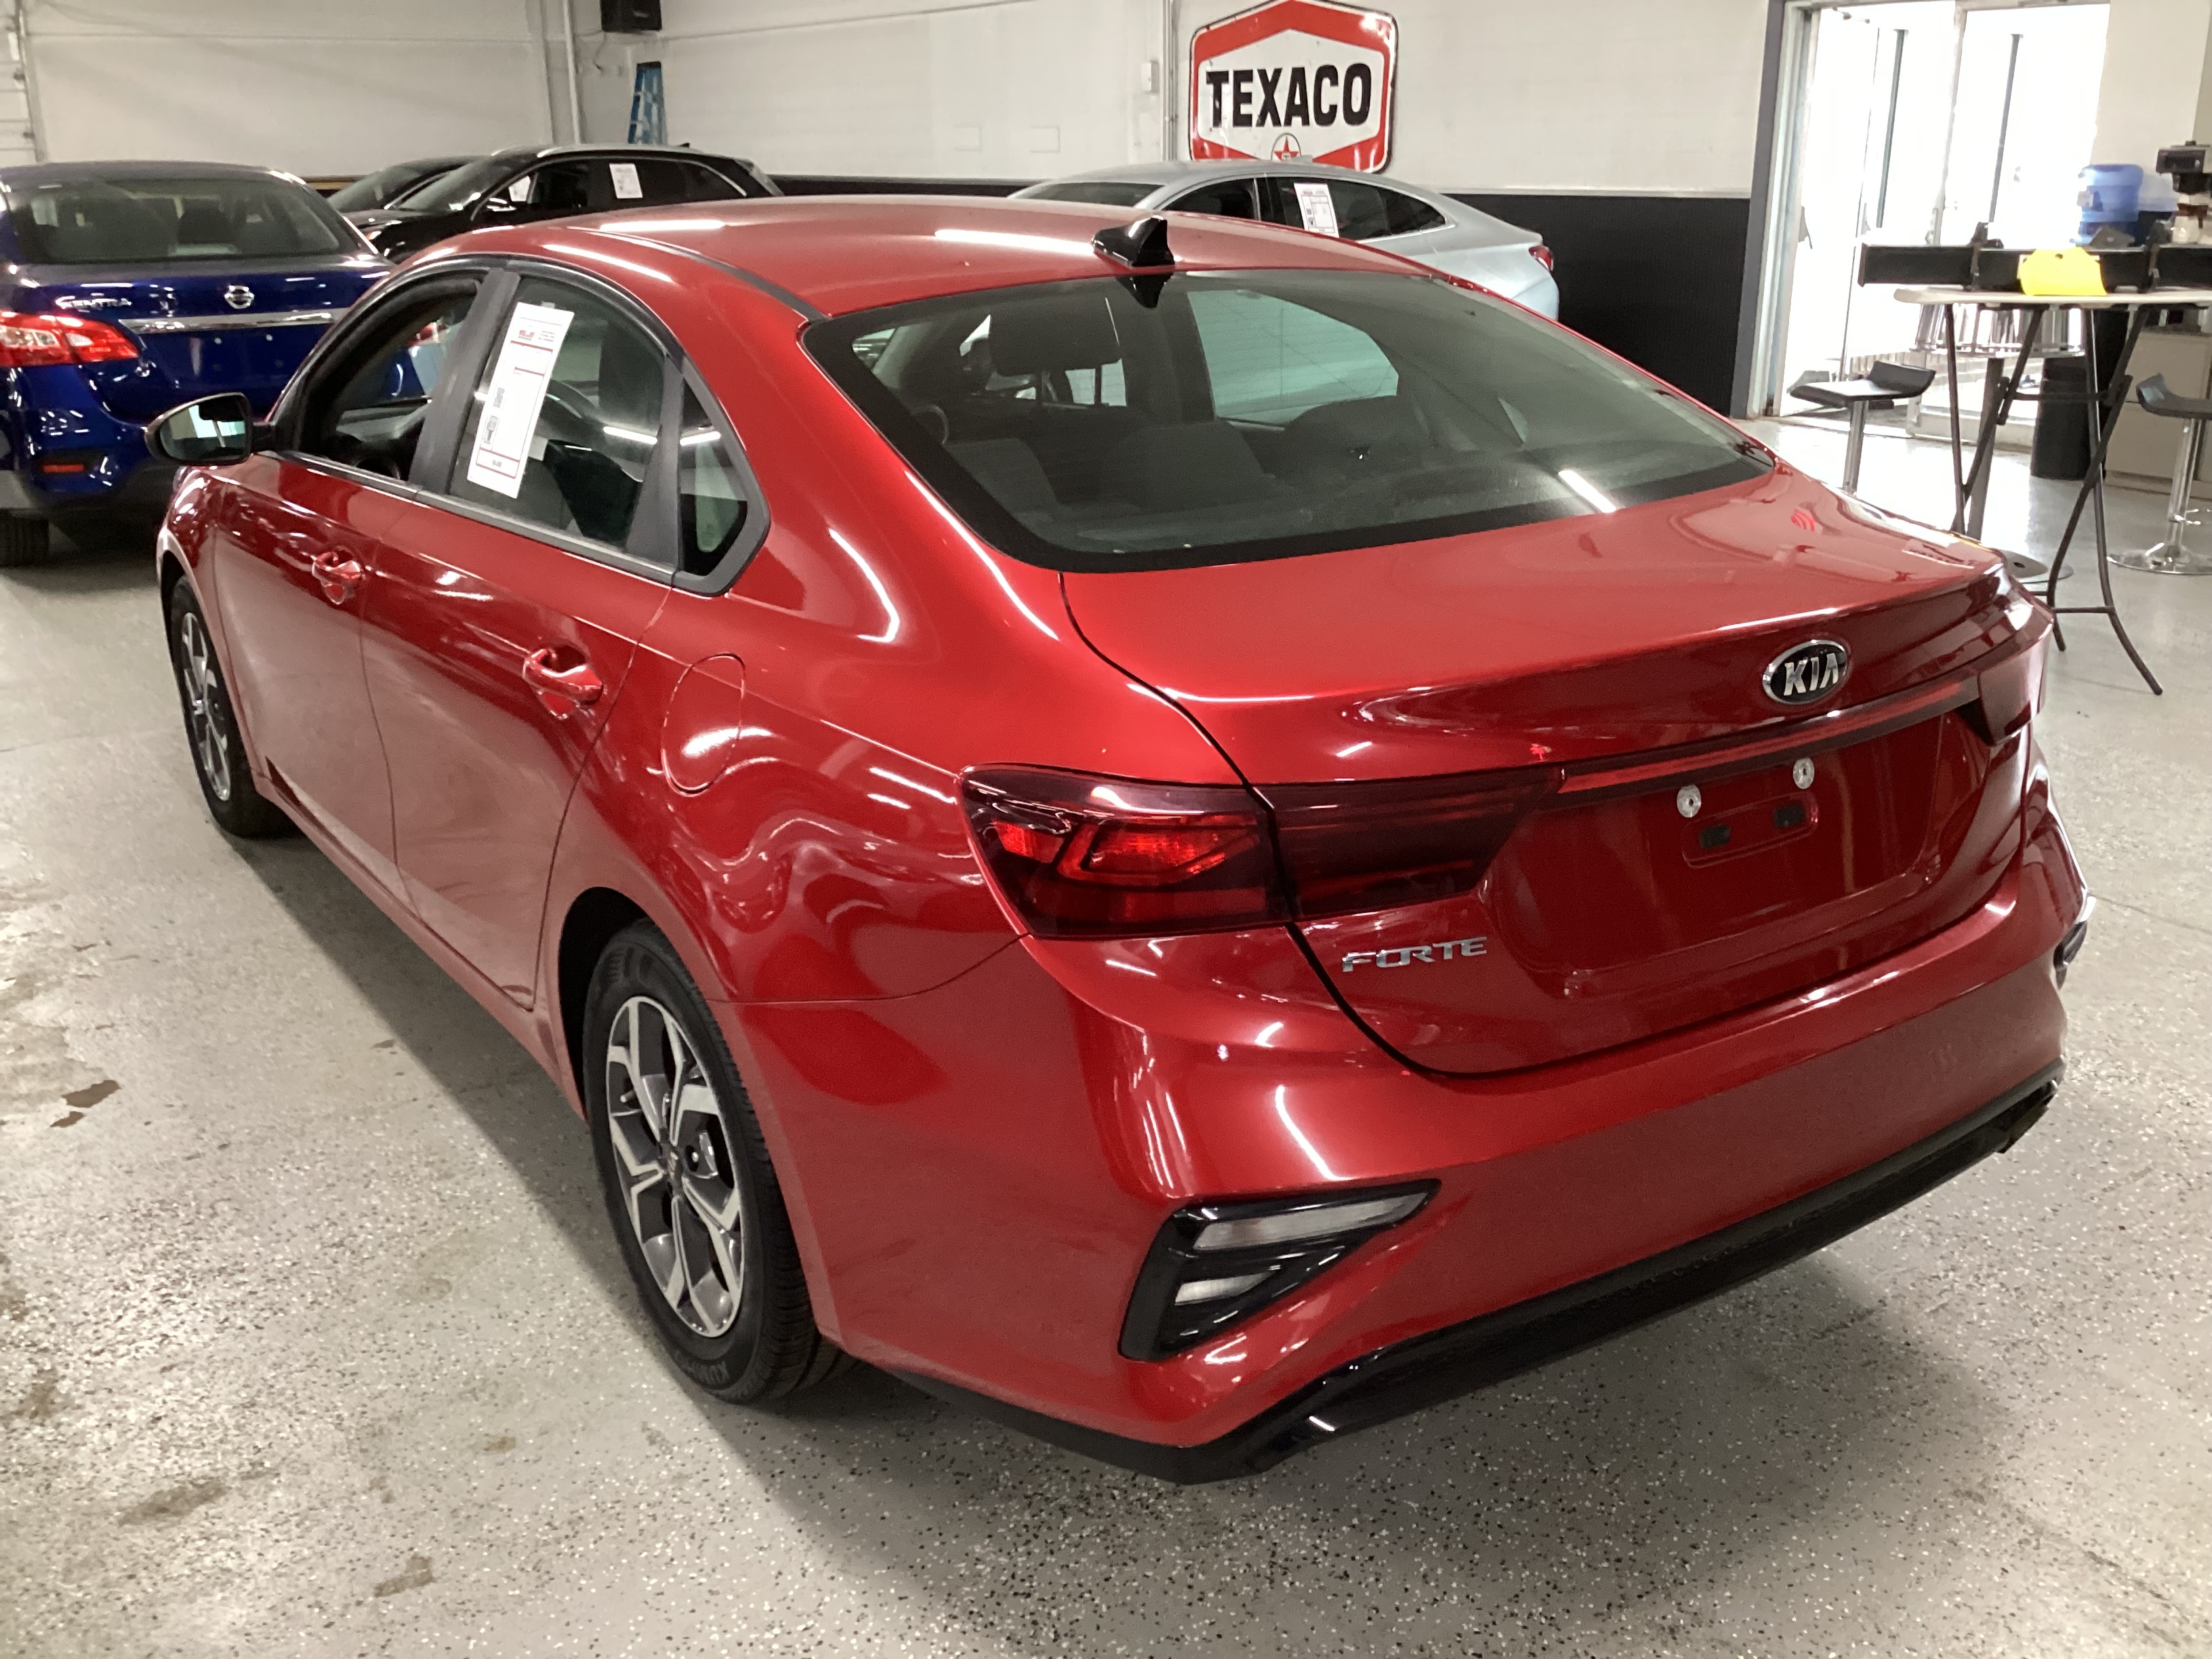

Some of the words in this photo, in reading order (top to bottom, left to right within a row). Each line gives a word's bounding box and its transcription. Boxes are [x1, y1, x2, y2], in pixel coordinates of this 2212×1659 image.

[1206, 63, 1372, 127] TEXACO
[1784, 653, 1839, 696] KIA
[1342, 936, 1488, 972] FORTE
